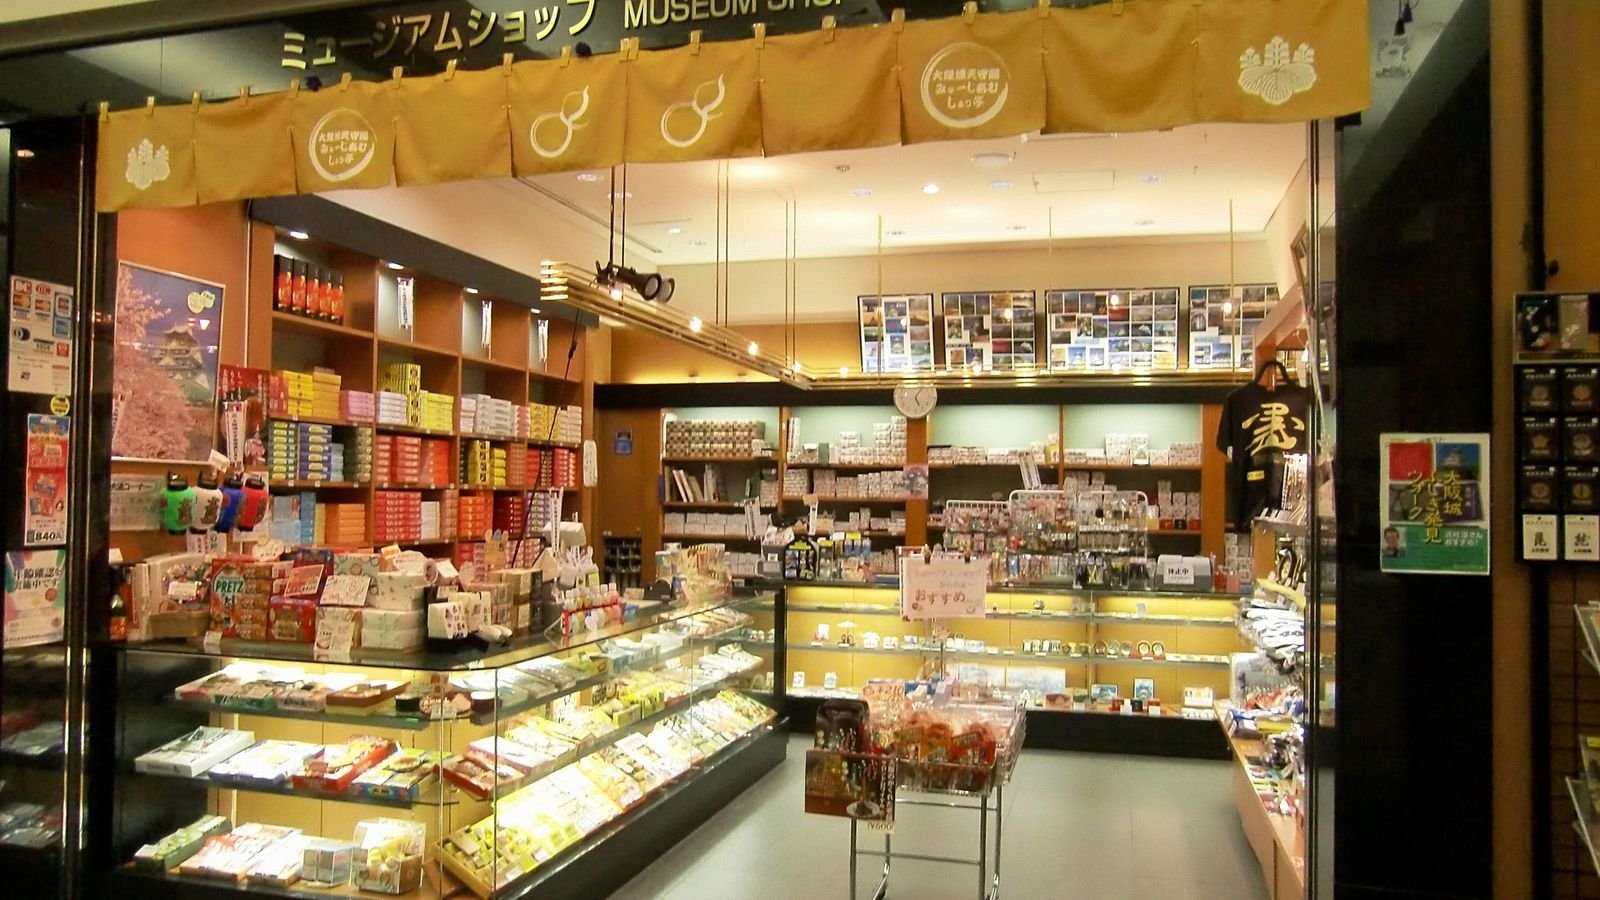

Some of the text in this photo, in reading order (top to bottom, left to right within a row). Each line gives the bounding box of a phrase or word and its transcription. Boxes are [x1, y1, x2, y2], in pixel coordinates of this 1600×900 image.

[1443, 470, 1464, 517] 大阪城
[216, 580, 245, 593] PRETZ
[915, 590, 966, 605] おすすめ
